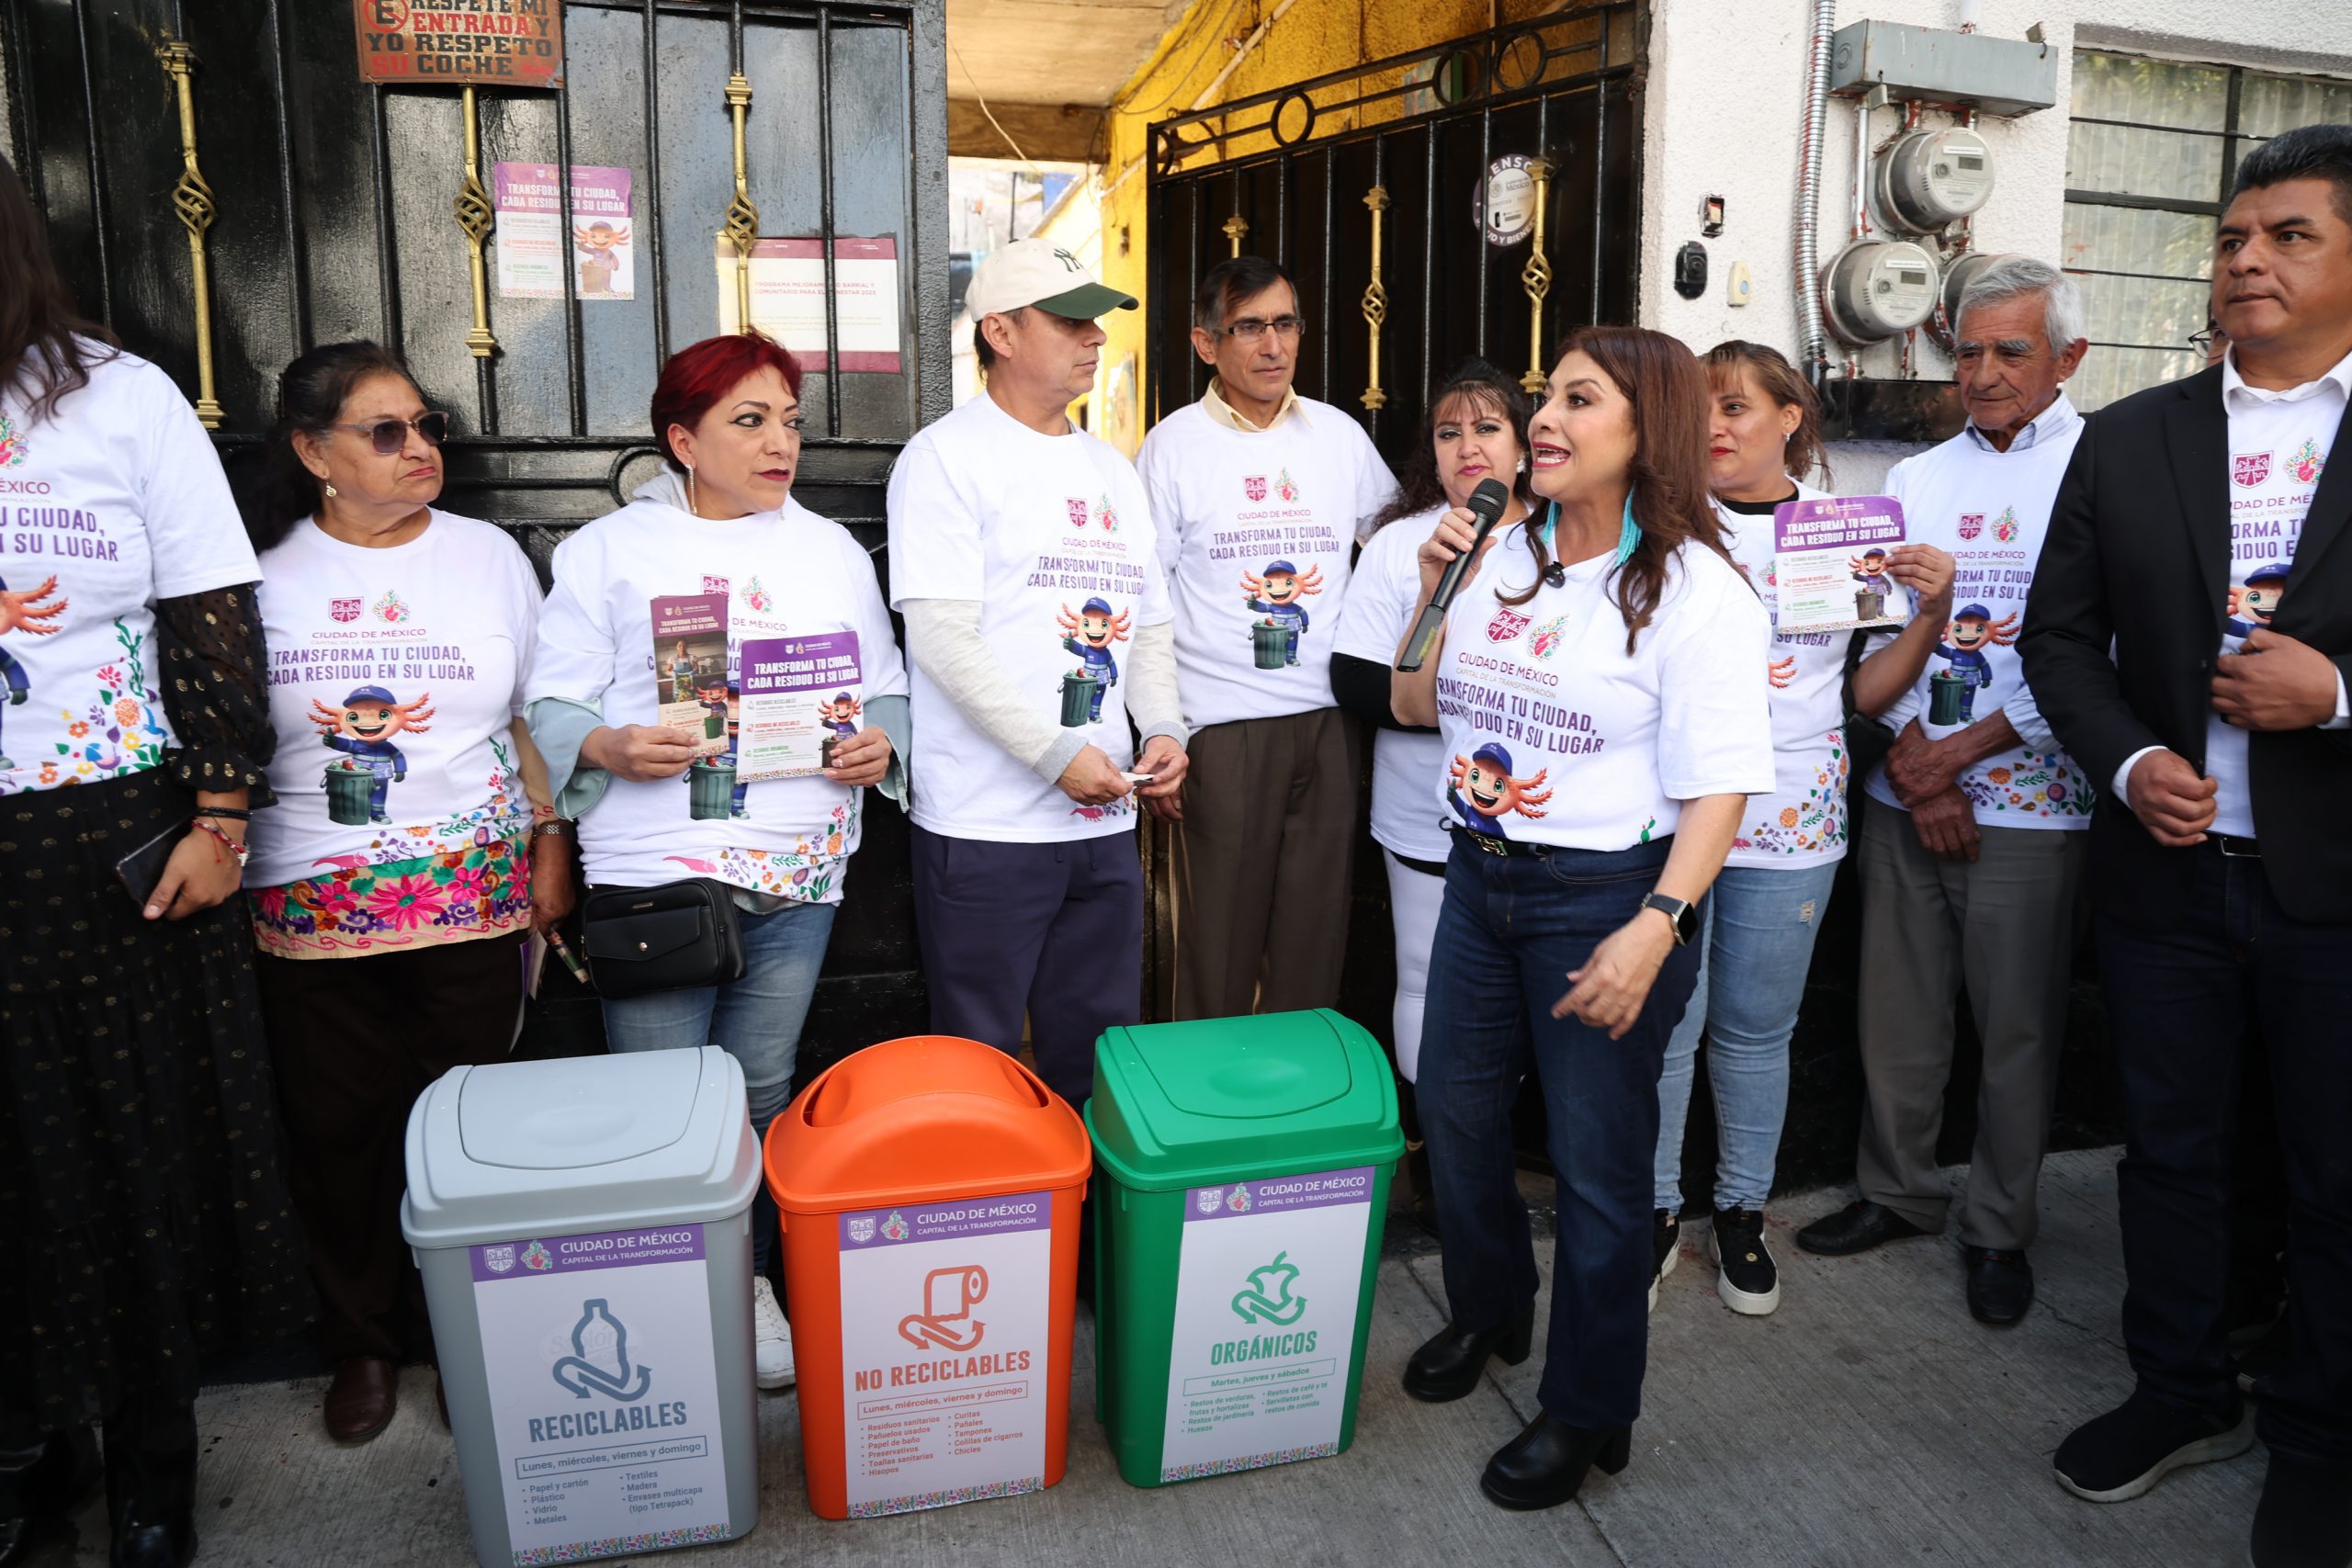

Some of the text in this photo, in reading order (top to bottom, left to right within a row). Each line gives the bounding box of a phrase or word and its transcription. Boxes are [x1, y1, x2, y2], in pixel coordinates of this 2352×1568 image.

[413, 12, 550, 36] ENTRADA Y
[365, 32, 551, 56] YO RESPETO
[371, 54, 513, 74] SU COCHE
[583, 186, 619, 200] CIUDAD,
[501, 196, 625, 211] CADA SU LUGAR
[2267, 496, 2286, 506] DE
[17, 506, 104, 536] CIUDAD,
[1237, 511, 1268, 519] CIUDAD
[1785, 514, 1894, 534] TRANSFORMA TU CIUDAD,
[1214, 525, 1335, 544] TRANSFORMA TU CIUDAD,
[1780, 526, 1900, 547] CADA RESIDUO SU LUGAR
[14, 533, 41, 553] SU
[52, 534, 119, 561] LUGAR
[1209, 541, 1310, 558] CADA RESIDUO EN SU
[1101, 560, 1112, 573] TU
[1027, 573, 1123, 592] CADA EN SU
[1987, 570, 2000, 581] TU
[1982, 585, 1996, 597] EN
[1998, 585, 2014, 598] SU
[380, 627, 425, 637] MÉXICO
[1796, 633, 1831, 647] LUGAR
[275, 645, 465, 664] TRANSFORMA TU CIUDAD,
[306, 664, 474, 681] RESIDUO EN SU LUGAR
[754, 660, 814, 674] TRANSFORMA
[816, 658, 825, 669] TU
[1455, 667, 1478, 679] CAPITAL
[1458, 651, 1558, 686] CIUDAD DE MÉXICO
[747, 667, 858, 688] CADA RESIDUO EN SU LUGAR
[1510, 694, 1597, 736] TU CIUDAD,
[1506, 718, 1604, 754] EN SU LUGAR
[1259, 1176, 1365, 1196] CIUDAD DE MÉXICO
[1258, 1198, 1283, 1207] CAPITAL
[1305, 1190, 1363, 1201] TRANSFORMACIÓN
[917, 1202, 1036, 1224] CIUDAD DE MÉXICO
[917, 1225, 945, 1235] CAPITAL
[969, 1216, 1036, 1229] TRANSFORMACIÓN
[560, 1231, 692, 1253] CIUDAD DE MÉXICO
[561, 1255, 593, 1264] CAPITAL
[607, 1252, 618, 1260] LA
[620, 1246, 693, 1259] TRANSFORMACIÓN
[1210, 1330, 1317, 1365] ORGÁNICOS
[854, 1349, 1030, 1391] NO RECICLABLES
[1211, 1367, 1309, 1387] Martes, jueves sábados
[1267, 1388, 1289, 1396] Restos
[1300, 1382, 1315, 1392] café
[863, 1385, 1023, 1413] Lunes, miércoles, viernes domingo
[1190, 1399, 1213, 1407] Restos
[1225, 1393, 1255, 1402] verduras,
[1264, 1399, 1319, 1414] restos comida
[1265, 1395, 1299, 1404] Servilletas
[954, 1409, 979, 1419] Curitas
[1189, 1402, 1249, 1416] frutas hortalizas
[1222, 1409, 1254, 1420] jardinería
[528, 1401, 687, 1442] RECICLABLES
[867, 1415, 940, 1431] Residuos sanitarios
[954, 1418, 983, 1428] Pañales
[1187, 1425, 1212, 1433] Huesos
[867, 1426, 930, 1439] Pañuelos usados
[954, 1437, 981, 1446] Colillas
[993, 1430, 1023, 1441] cigarros
[955, 1427, 992, 1437] Tampones
[867, 1439, 889, 1450] Papel
[901, 1436, 920, 1444] baño
[954, 1445, 980, 1454] Chicles
[522, 1442, 701, 1471] Lunes, miércoles, viernes domingo
[868, 1445, 919, 1459] Preservativos
[868, 1451, 933, 1467] Toallas sanitarias
[625, 1470, 658, 1480] Textiles
[868, 1466, 899, 1476] Hisopos
[529, 1477, 588, 1495] Papel cartón
[627, 1480, 657, 1491] Madera
[628, 1484, 702, 1502] Envases multicapa
[531, 1492, 565, 1503] Plástico
[628, 1496, 694, 1514] (tipo Tetrapack)
[532, 1504, 557, 1514] Vidrio
[533, 1514, 567, 1524] Metales
